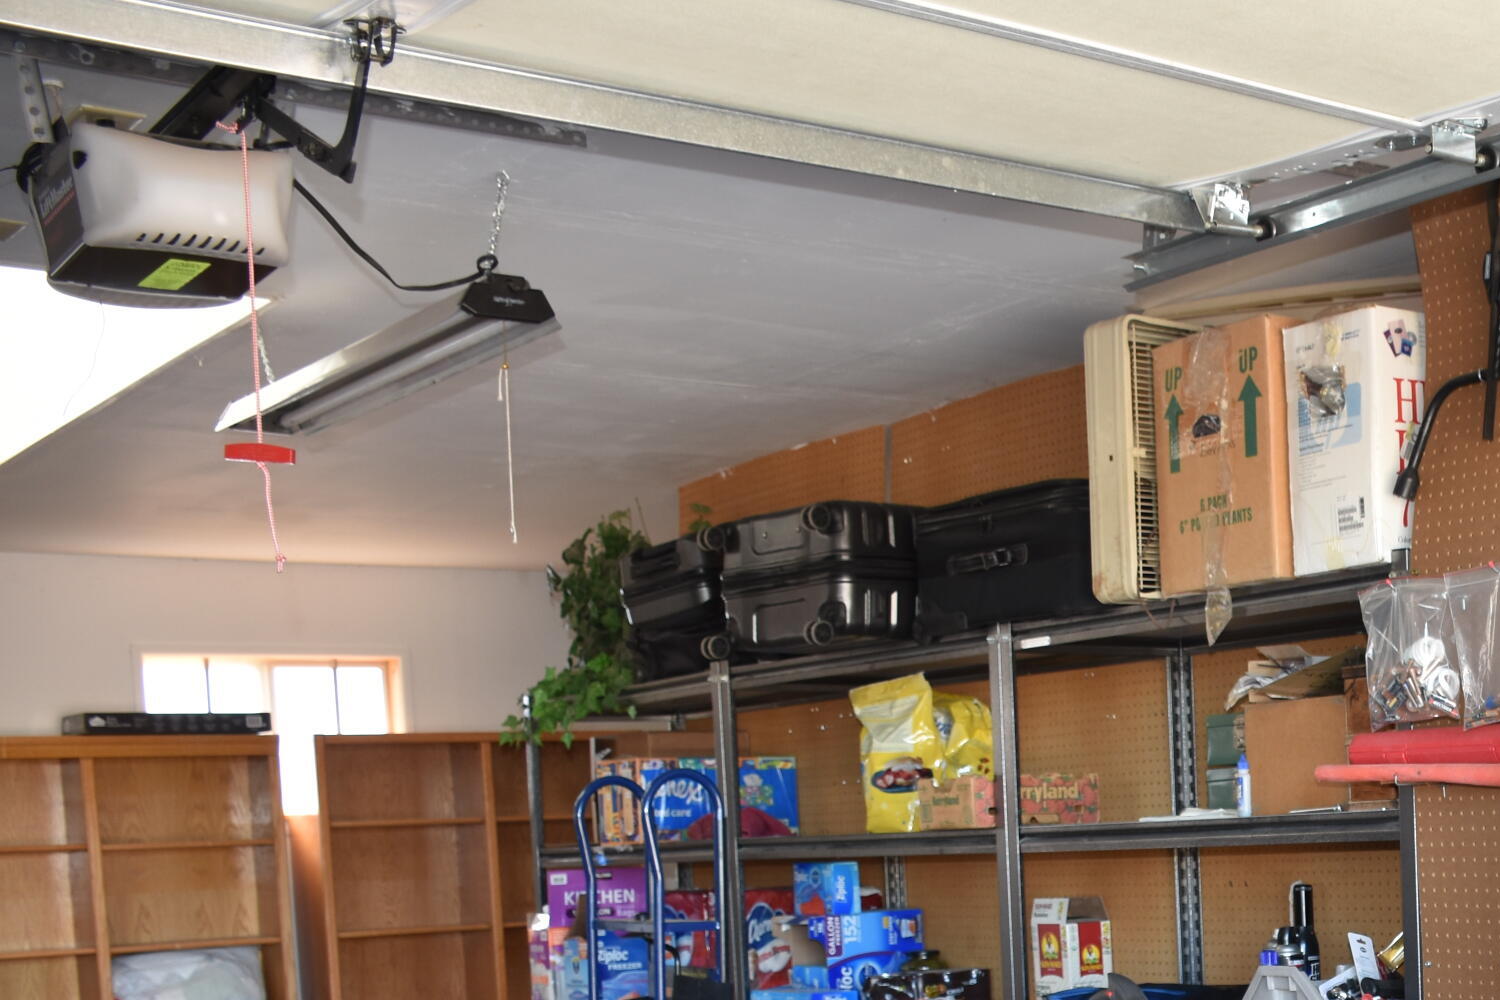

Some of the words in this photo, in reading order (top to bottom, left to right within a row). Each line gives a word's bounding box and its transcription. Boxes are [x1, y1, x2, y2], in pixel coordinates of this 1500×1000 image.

[1238, 345, 1258, 373] UP
[1164, 366, 1183, 392] UP
[1020, 781, 1079, 804] rryland
[825, 916, 837, 956] GALLON
